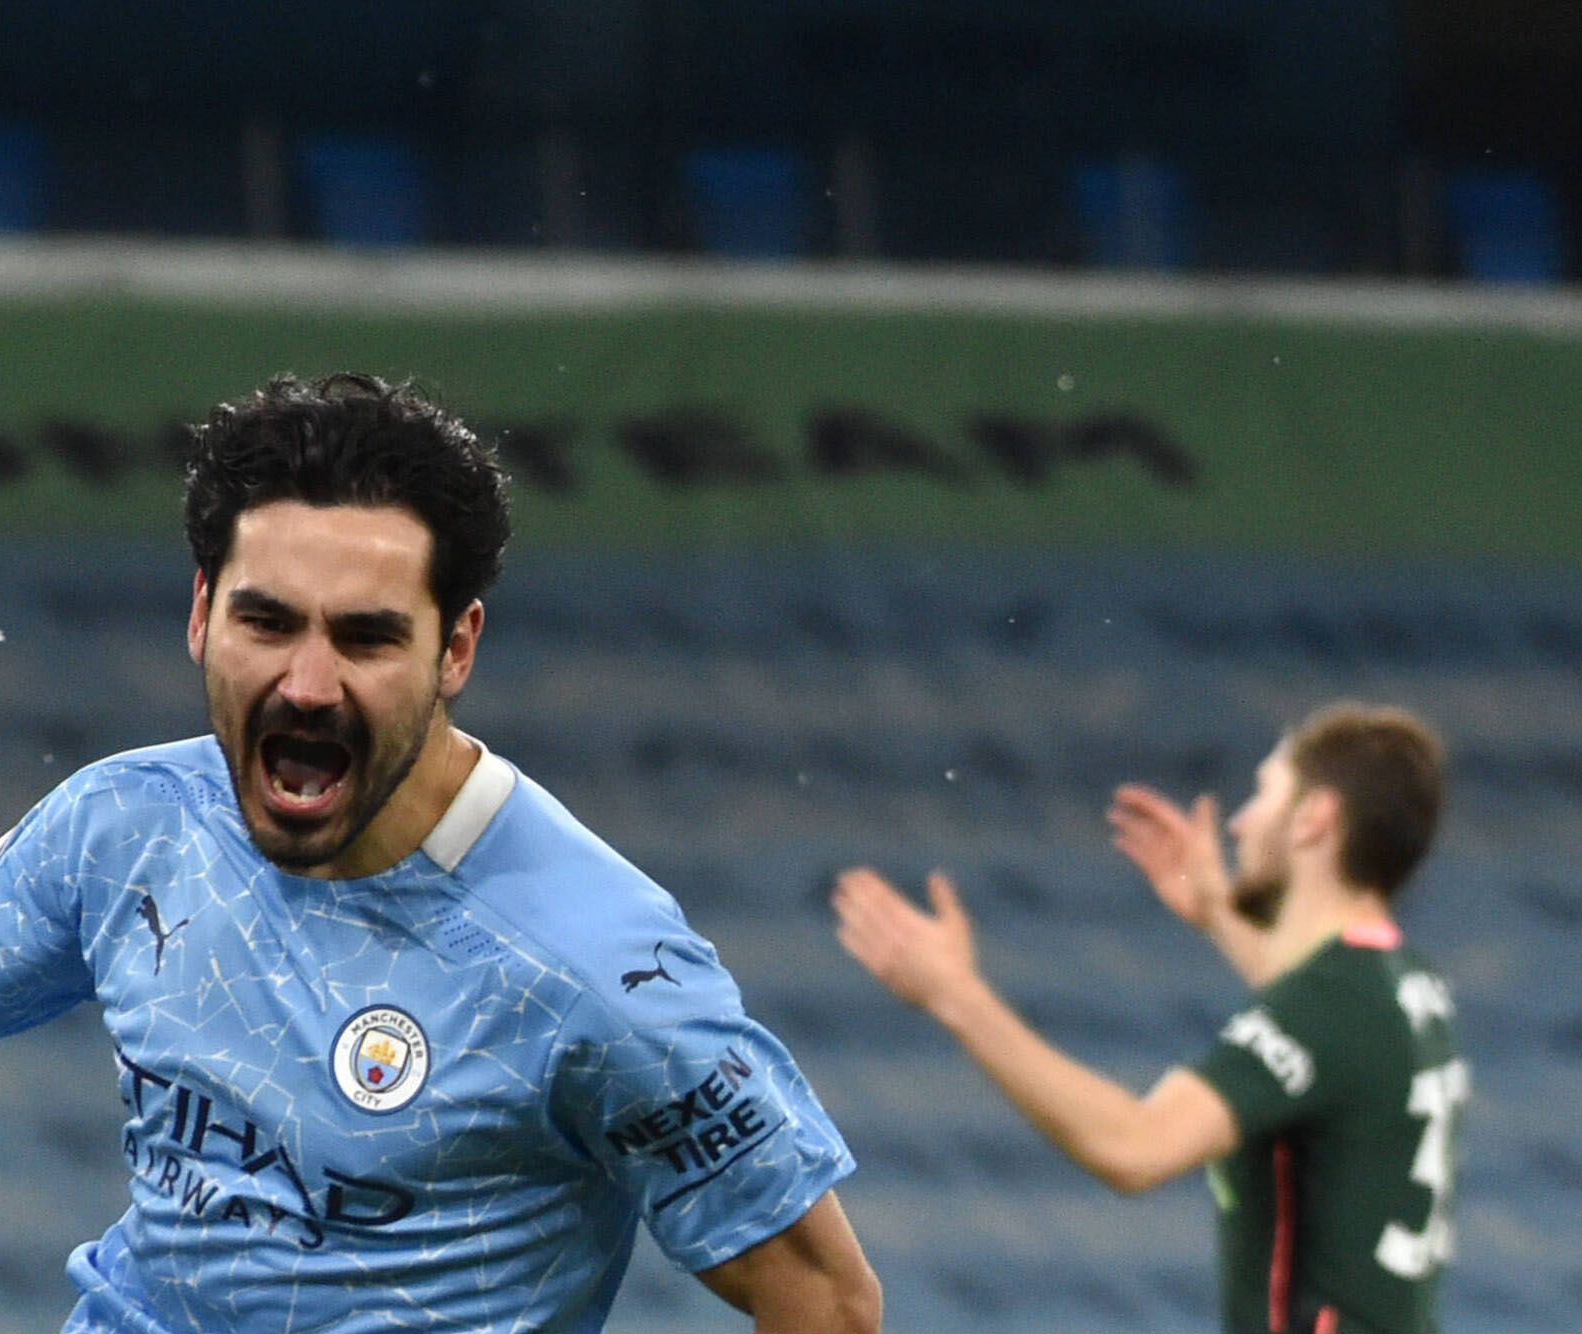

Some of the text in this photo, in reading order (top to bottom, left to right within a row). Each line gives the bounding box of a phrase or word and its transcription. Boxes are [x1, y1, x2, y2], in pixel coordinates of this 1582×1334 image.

[350, 1012, 424, 1059] MANCHESTER
[116, 1044, 417, 1228] TIHAD
[353, 1090, 382, 1108] CITY
[605, 1045, 752, 1156] NEXEN
[651, 1098, 766, 1174] TIRE
